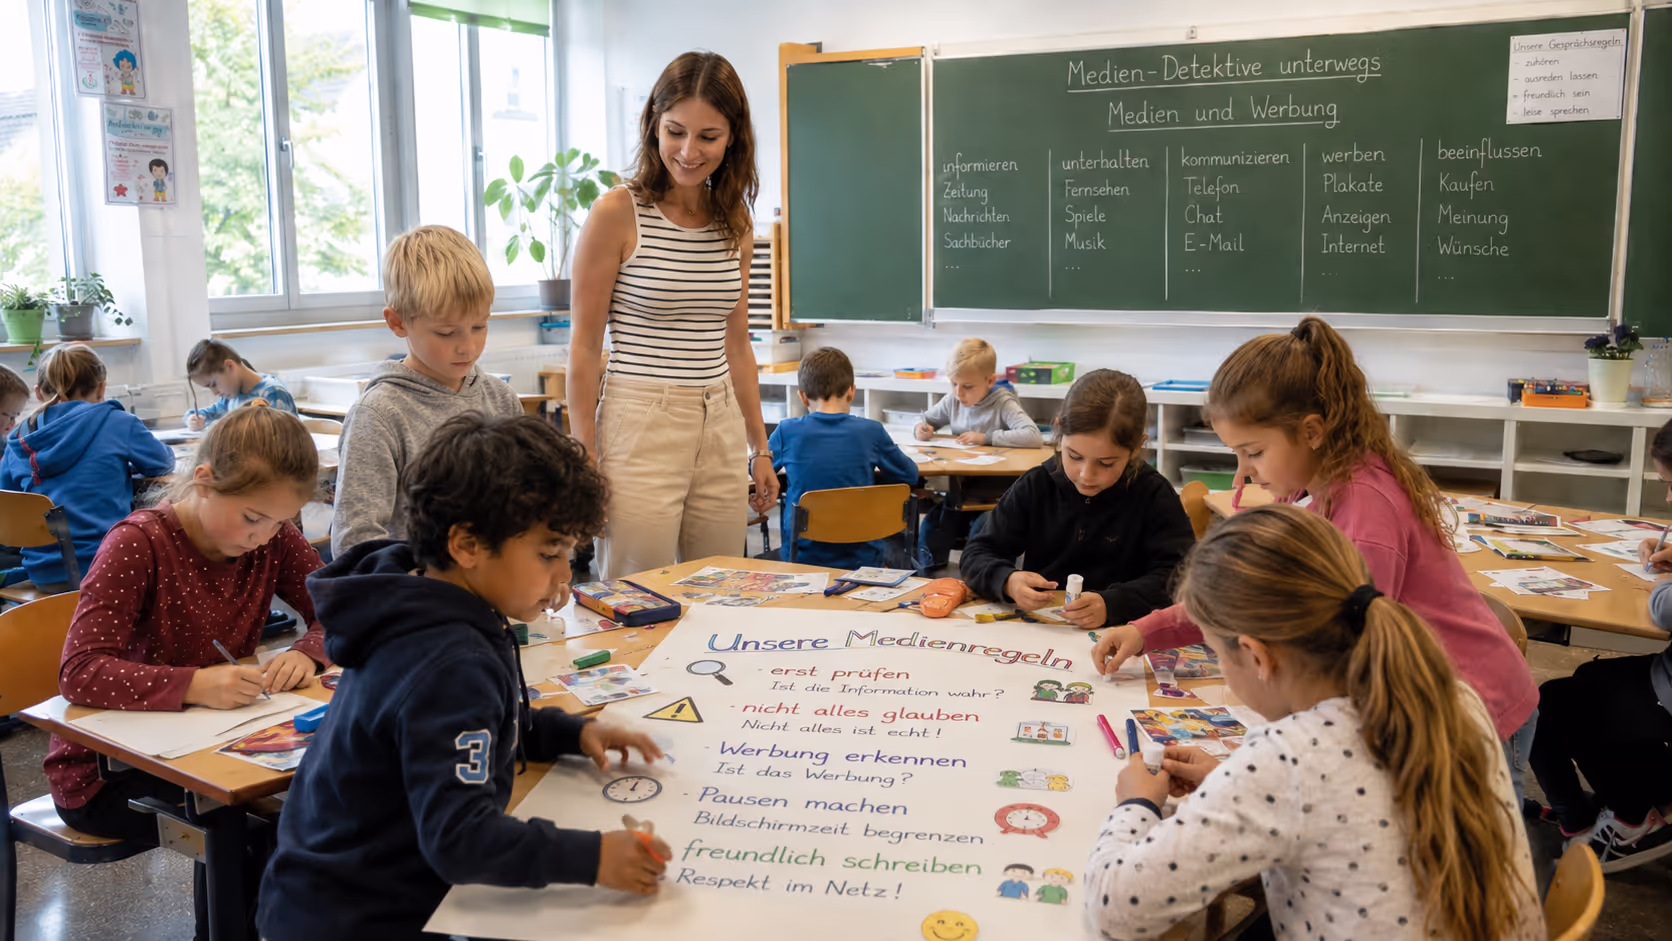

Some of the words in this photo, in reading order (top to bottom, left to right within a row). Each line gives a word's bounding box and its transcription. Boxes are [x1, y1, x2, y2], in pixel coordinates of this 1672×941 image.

[1513, 42, 1543, 51] Unsere
[1548, 36, 1621, 51] Gesprächsregeln
[1067, 53, 1262, 87] Medien-Detektive
[1280, 49, 1381, 83] unterwegs
[1525, 57, 1560, 66] zuhören
[1524, 72, 1563, 83] ausreden
[1570, 71, 1598, 80] lassen
[1523, 89, 1566, 102] freundlich
[1108, 100, 1180, 126] Medien
[1195, 96, 1234, 122] und
[1250, 94, 1339, 128] Werbung
[1523, 107, 1542, 117] leise
[1550, 105, 1590, 118] sprechen
[1062, 149, 1150, 170] unterhalten
[1181, 146, 1290, 167] kommunizieren
[1321, 137, 1386, 163] werben
[1438, 137, 1542, 168] beeinflussen
[942, 152, 1019, 180] informieren
[943, 181, 989, 204] Zeitung
[1065, 179, 1130, 197] Fernsehen
[1183, 176, 1240, 202] Telefon
[1323, 173, 1384, 193] Plakate
[1439, 171, 1495, 200] Kaufen
[943, 207, 1011, 223] Nachrichten
[1065, 205, 1106, 229] Spiele
[1185, 204, 1224, 224] Chat
[1321, 204, 1392, 233] Anzeigen
[1438, 204, 1509, 235] Meinung
[944, 232, 1011, 250] Sachbücher
[1065, 232, 1106, 250] Musik
[1184, 233, 1245, 252] E-Mail
[1321, 233, 1386, 254] Internet
[1438, 236, 1510, 257] Wünsche
[707, 633, 829, 651] Unsere
[845, 630, 1073, 669] Medienregeln
[770, 666, 818, 676] erst
[831, 667, 910, 681] prüfen
[770, 681, 796, 691] Ist
[805, 683, 831, 693] die
[840, 684, 939, 697] Information
[742, 702, 800, 715] nicht
[814, 704, 869, 718] alles
[881, 707, 979, 723] glauben
[741, 719, 789, 732] Nicht
[800, 723, 841, 734] alles
[852, 725, 876, 736] ist
[454, 729, 492, 785] 3
[719, 741, 829, 766] Werbung
[845, 750, 967, 768] erkennen
[712, 761, 745, 776] Ist
[756, 765, 792, 778] das
[698, 786, 788, 808] Pausen
[804, 798, 908, 815] machen
[692, 811, 850, 836] Bildschirmzeit
[863, 823, 984, 845] begrenzen
[681, 838, 826, 867] freundlich
[842, 852, 982, 875] schreiben
[676, 867, 770, 891] Respekt
[785, 879, 813, 893] im
